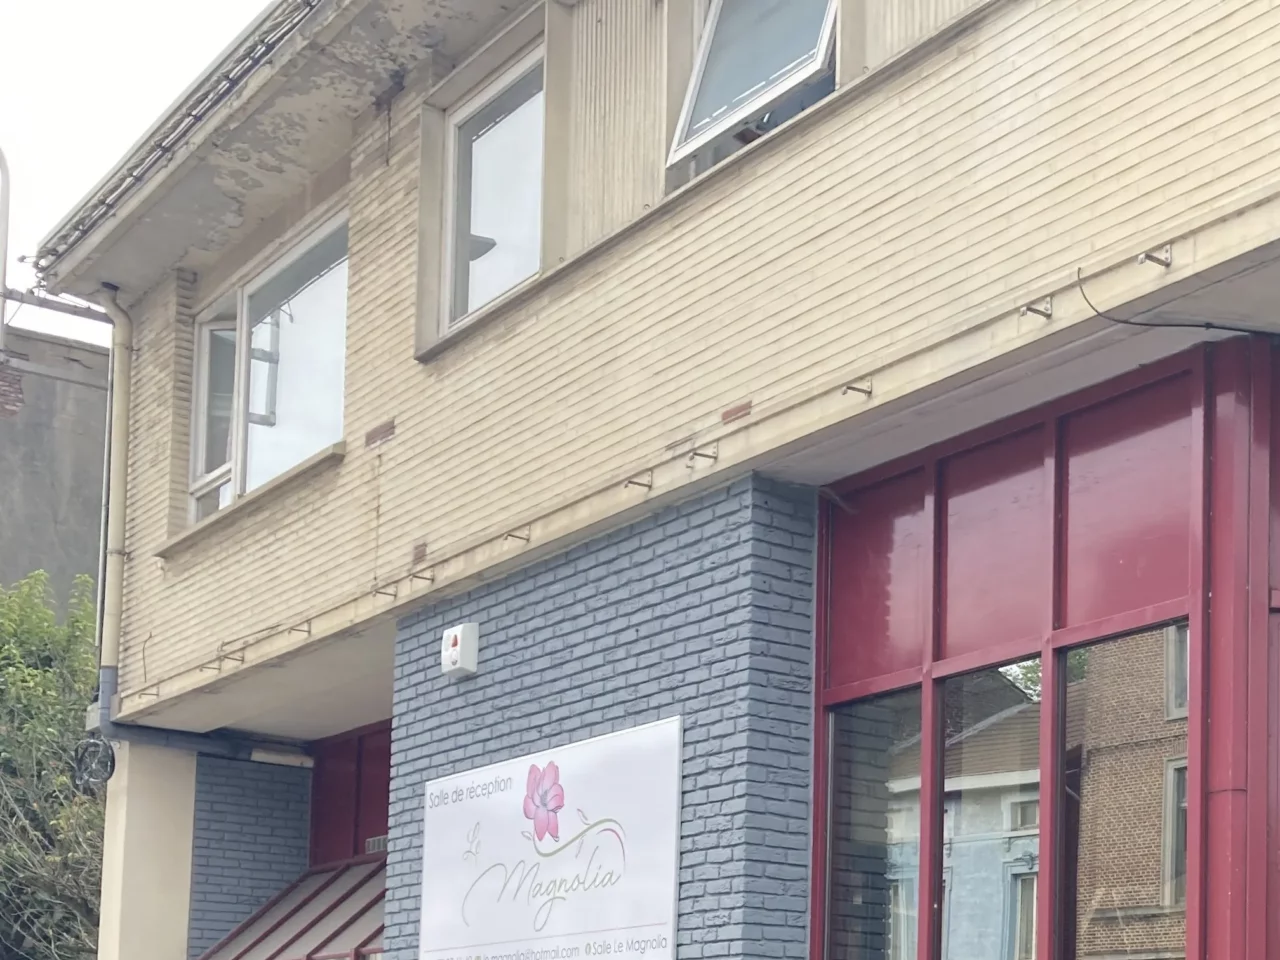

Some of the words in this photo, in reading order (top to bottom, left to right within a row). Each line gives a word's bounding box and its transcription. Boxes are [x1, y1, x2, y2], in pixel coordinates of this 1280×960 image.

[428, 789, 449, 809] Salle
[451, 785, 464, 804] de
[465, 776, 512, 799] réception
[461, 845, 622, 932] Magnolia
[593, 940, 611, 955] Salle
[613, 939, 624, 953] Le
[626, 934, 668, 954] Magnolia
